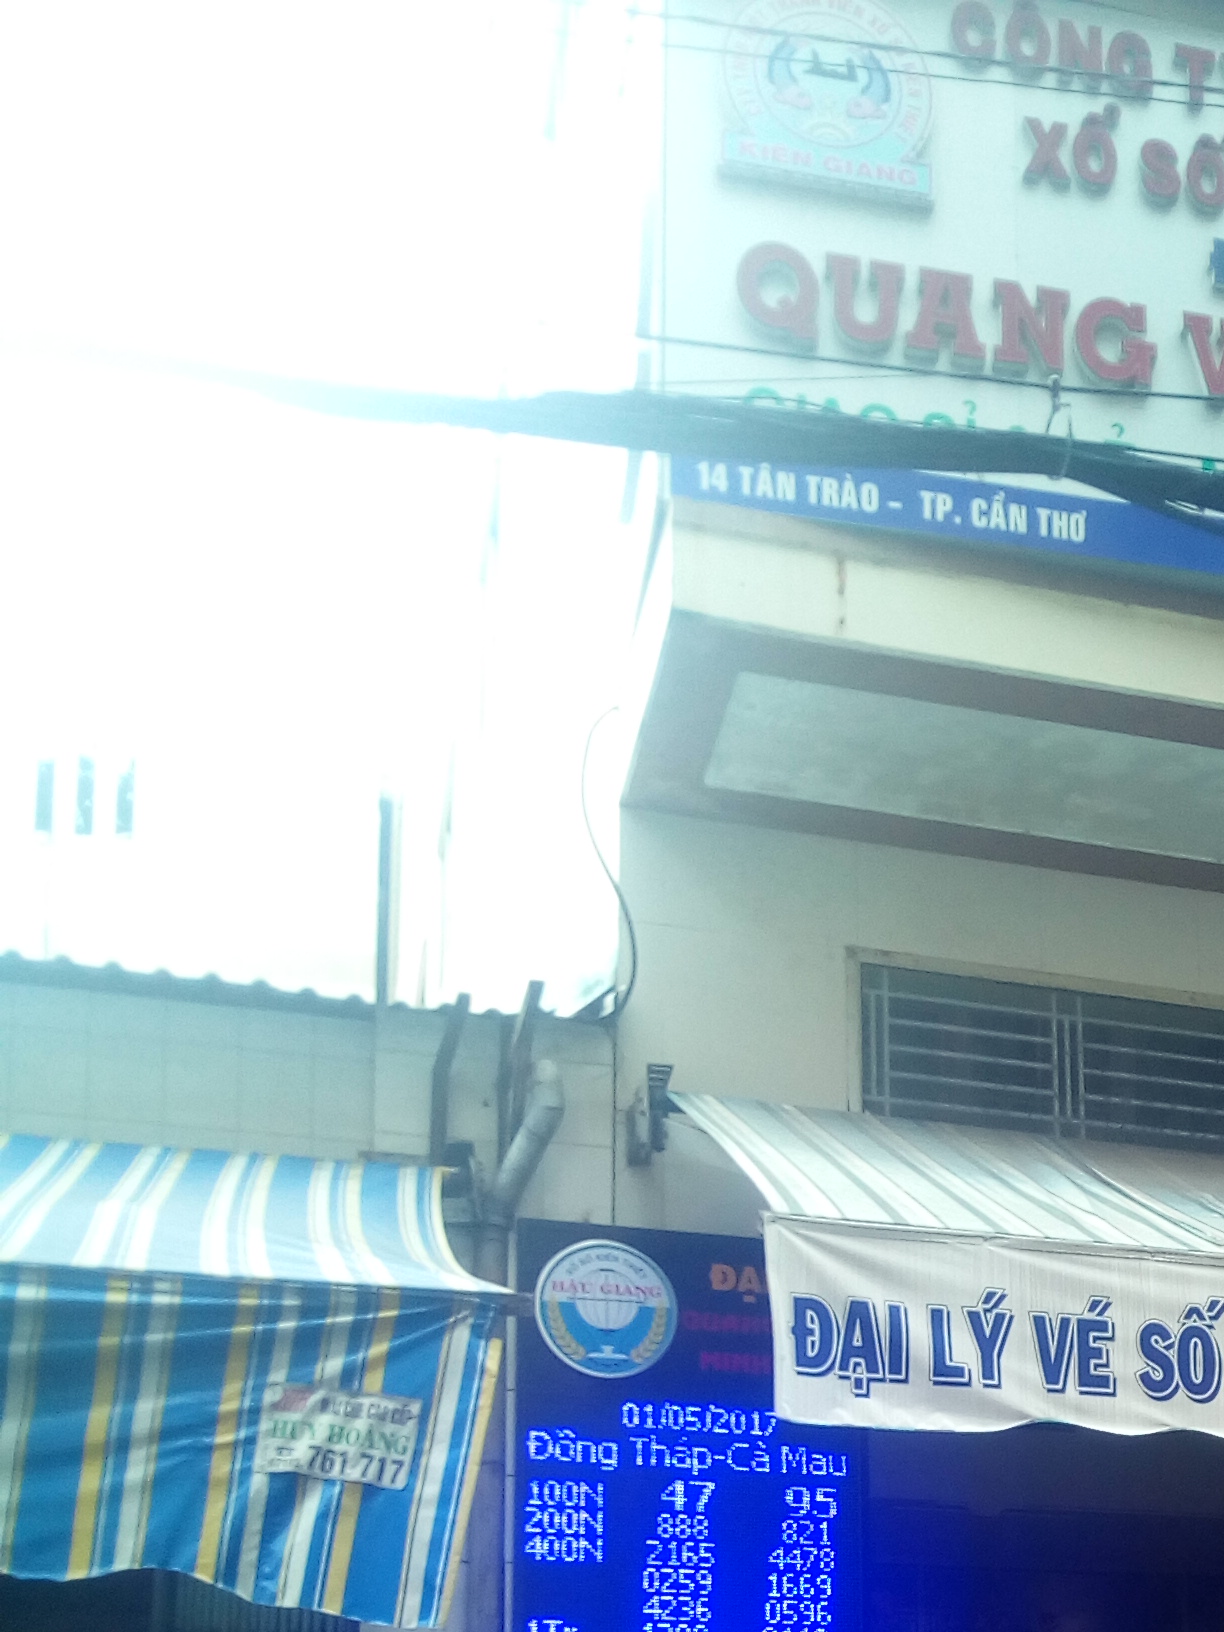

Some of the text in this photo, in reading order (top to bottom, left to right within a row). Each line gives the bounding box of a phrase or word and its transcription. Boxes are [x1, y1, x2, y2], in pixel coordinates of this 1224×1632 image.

[951, 0, 1153, 98] CÔNG
[823, 154, 918, 187] GIANG
[736, 241, 1158, 398] QUANG
[697, 461, 728, 493] 14
[739, 463, 796, 499] TÂN
[806, 474, 879, 513] TRÀO
[1037, 507, 1087, 543] THƠ
[600, 1280, 663, 1299] GIANG
[710, 1263, 769, 1303] ĐẠ
[790, 1292, 909, 1398] ĐẠI
[927, 1286, 1014, 1388] LÝ
[1028, 1295, 1117, 1397] VÉ
[360, 1452, 404, 1484] 717
[527, 1429, 618, 1471] Đồng
[780, 1445, 847, 1477] Mau
[528, 1480, 837, 1518] 100N 47 95
[524, 1507, 830, 1545] 200N 888 821
[525, 1536, 834, 1571] 400N 2165 4478
[643, 1568, 831, 1598] 0259 1669
[643, 1596, 831, 1625] 4236 0596
